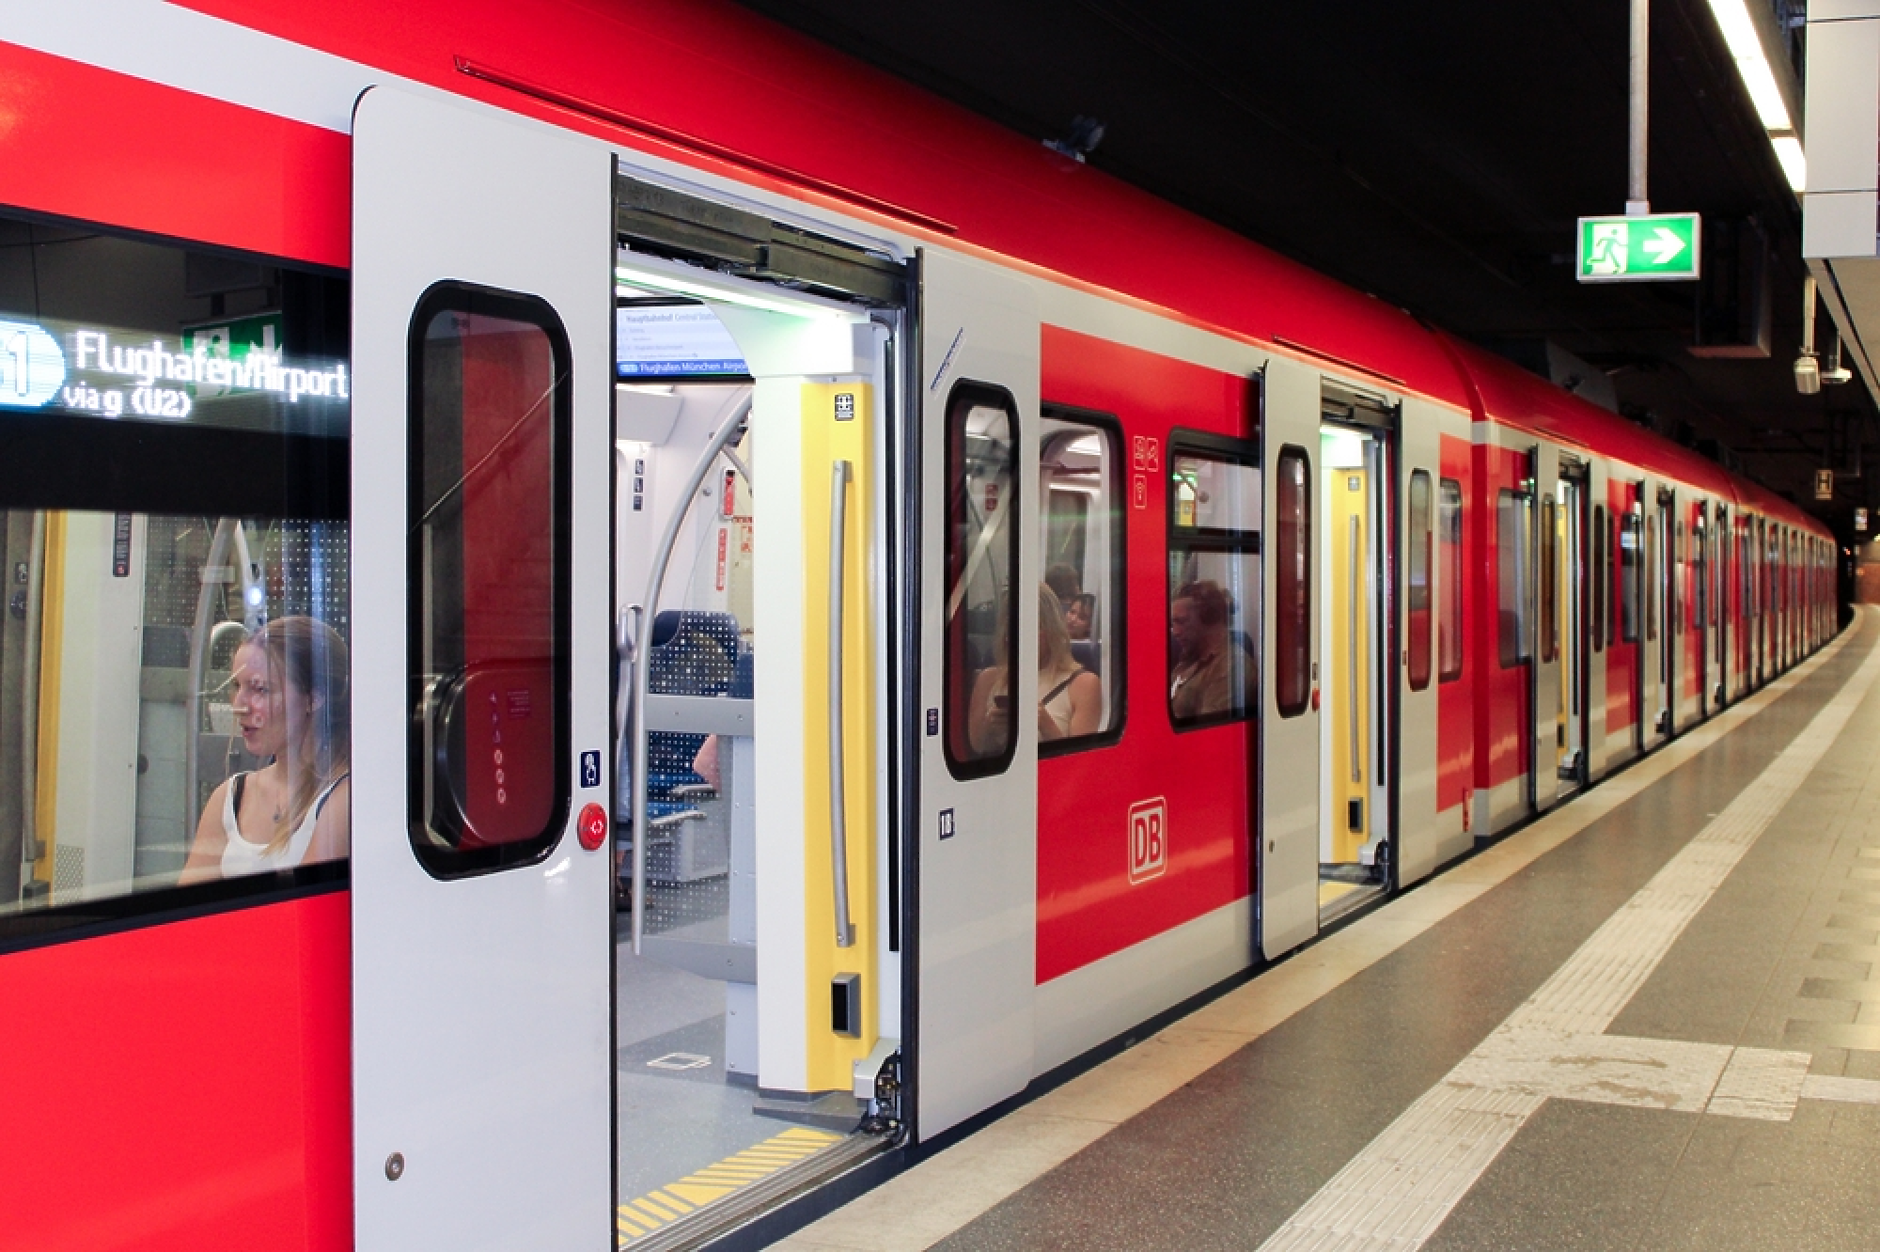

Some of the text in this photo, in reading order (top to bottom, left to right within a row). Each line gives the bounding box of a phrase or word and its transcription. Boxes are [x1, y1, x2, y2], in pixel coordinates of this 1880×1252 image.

[63, 381, 99, 407] via
[76, 330, 349, 402] Flughafen/Airport
[1134, 812, 1160, 869] DB
